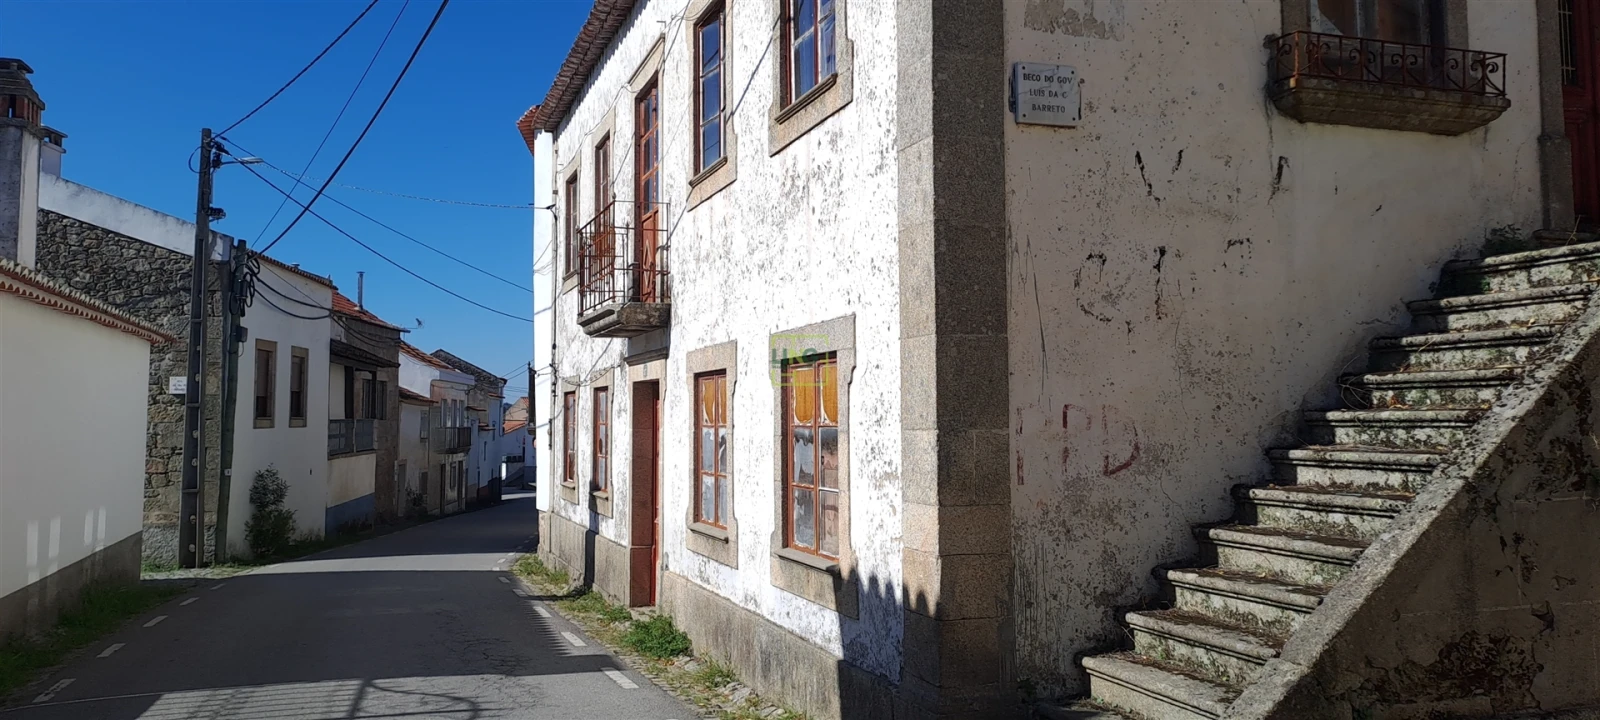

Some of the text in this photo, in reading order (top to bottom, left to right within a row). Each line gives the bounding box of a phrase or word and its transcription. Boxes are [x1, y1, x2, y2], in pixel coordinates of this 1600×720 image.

[1023, 73, 1040, 82] BECO
[1057, 76, 1072, 84] GOV
[1032, 104, 1066, 113] BARRETO
